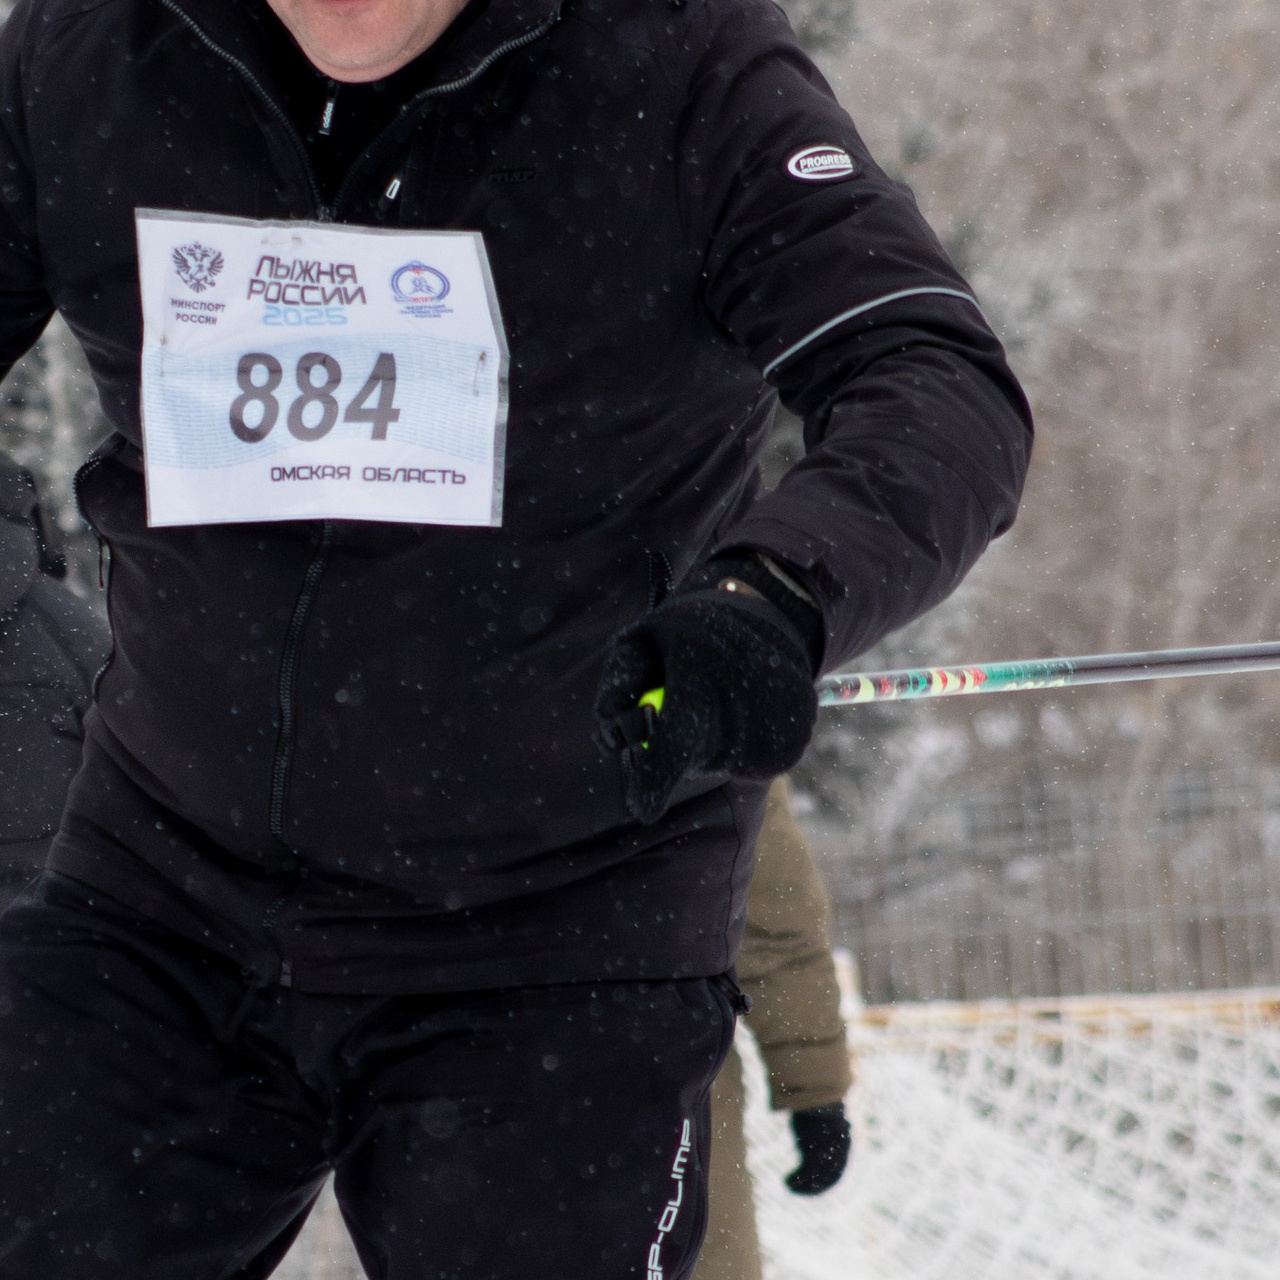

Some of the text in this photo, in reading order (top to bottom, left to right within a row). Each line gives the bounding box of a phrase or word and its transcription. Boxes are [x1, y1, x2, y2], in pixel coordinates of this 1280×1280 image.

[799, 154, 851, 169] PROGRESS
[255, 255, 358, 284] ЛЫЖНЯ
[247, 278, 367, 305] РОССИИ
[170, 298, 226, 313] МИНСПОРТ
[262, 305, 348, 326] 2025
[175, 312, 218, 325] РОССИИ
[229, 352, 401, 443] 884
[270, 465, 466, 484] ОМСКАЯ ОБЛАСТЬ
